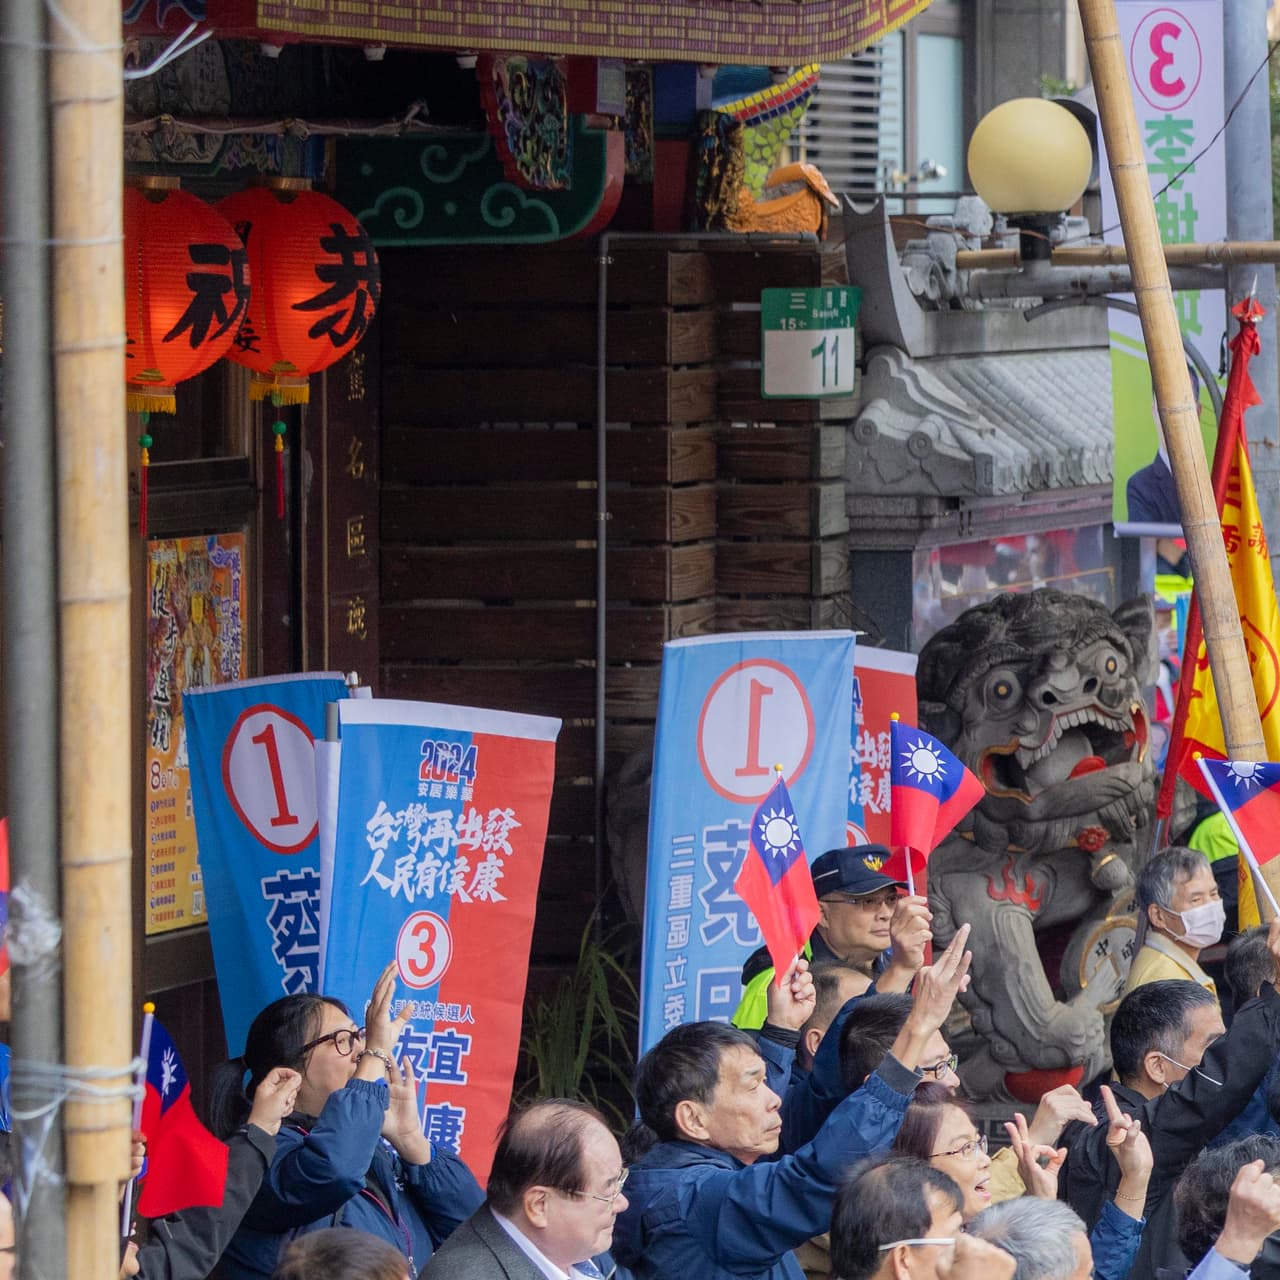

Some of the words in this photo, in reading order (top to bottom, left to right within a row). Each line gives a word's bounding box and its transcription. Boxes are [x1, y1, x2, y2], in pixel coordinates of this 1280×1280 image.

[780, 318, 797, 330] 15
[251, 723, 300, 827] 1
[419, 739, 479, 786] 2024
[417, 783, 474, 802] 安居樂業
[366, 800, 522, 858] 台灣再出發
[360, 849, 508, 904] 人民有侯康
[407, 920, 437, 978] 3
